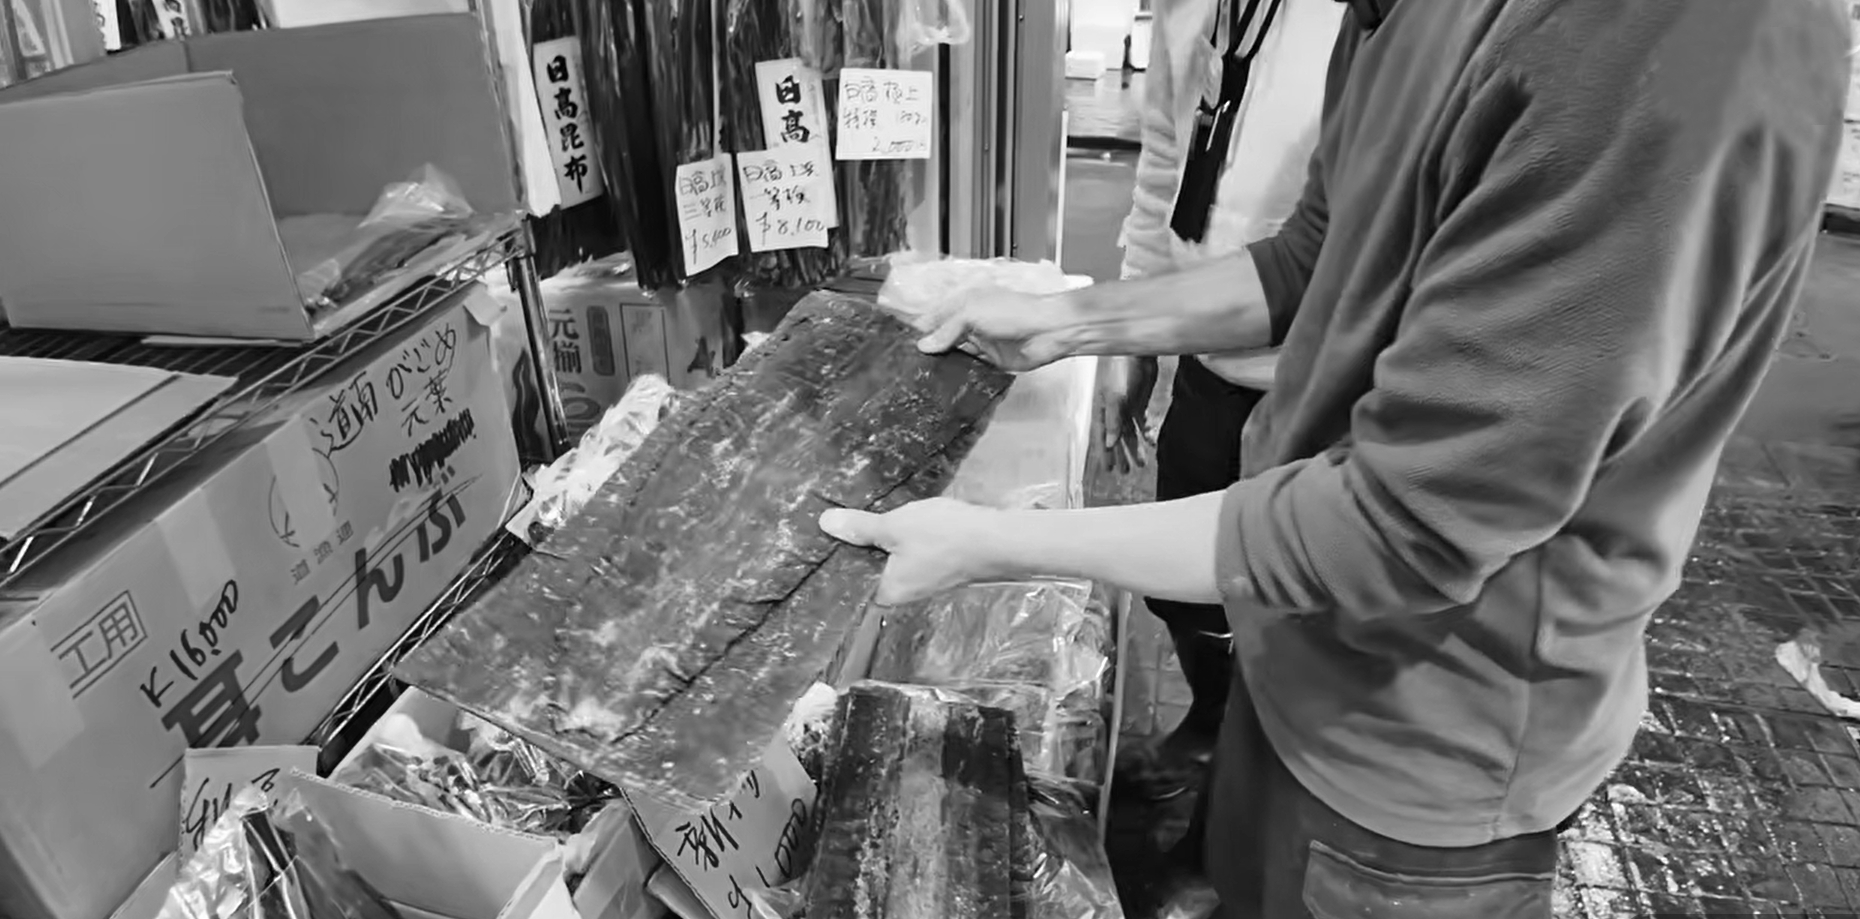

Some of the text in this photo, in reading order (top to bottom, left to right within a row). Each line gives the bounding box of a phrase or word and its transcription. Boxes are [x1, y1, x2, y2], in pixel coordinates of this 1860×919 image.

[547, 55, 588, 194] 日高昆布
[776, 75, 810, 143] 日高
